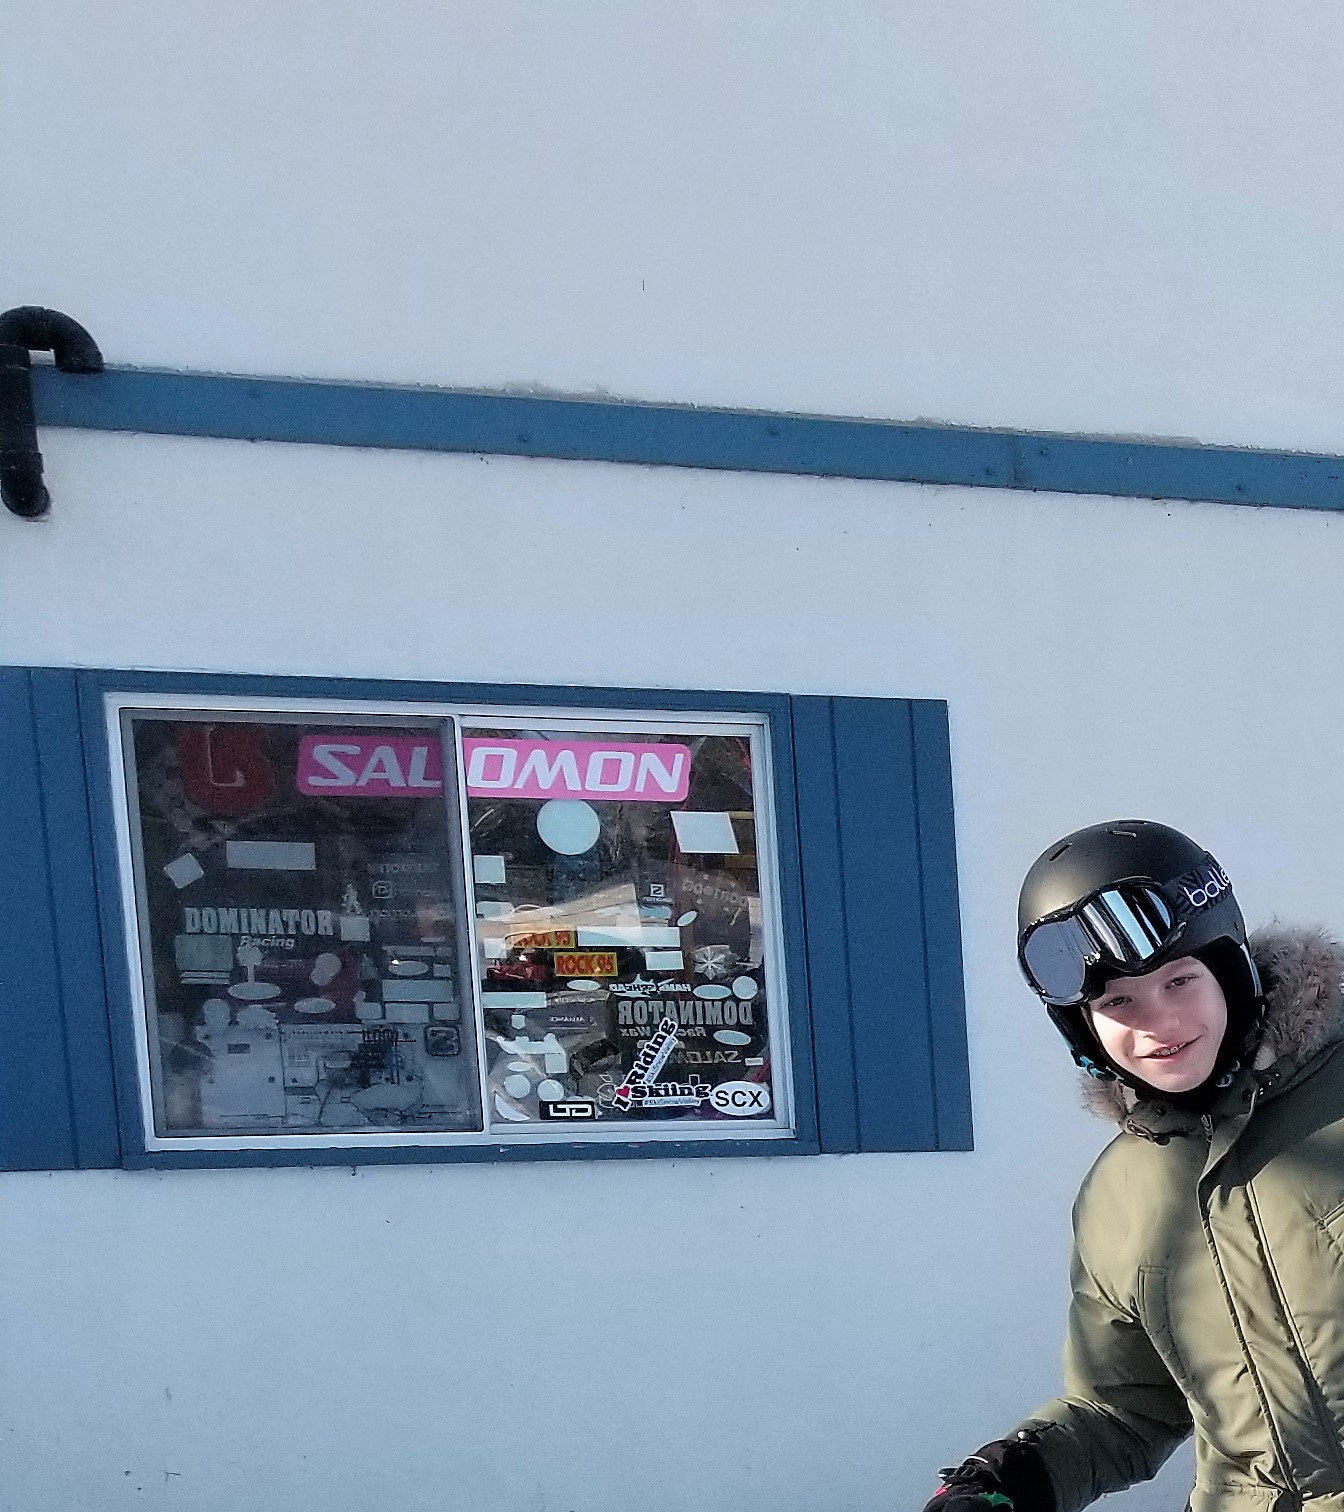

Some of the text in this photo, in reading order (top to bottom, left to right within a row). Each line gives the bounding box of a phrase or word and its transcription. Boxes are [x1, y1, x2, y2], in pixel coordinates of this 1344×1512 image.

[184, 907, 334, 936] DOMINATOR
[240, 936, 295, 949] Racing
[626, 1019, 676, 1085] Riding
[631, 1084, 710, 1100] Skiing
[714, 1090, 763, 1109] SCX
